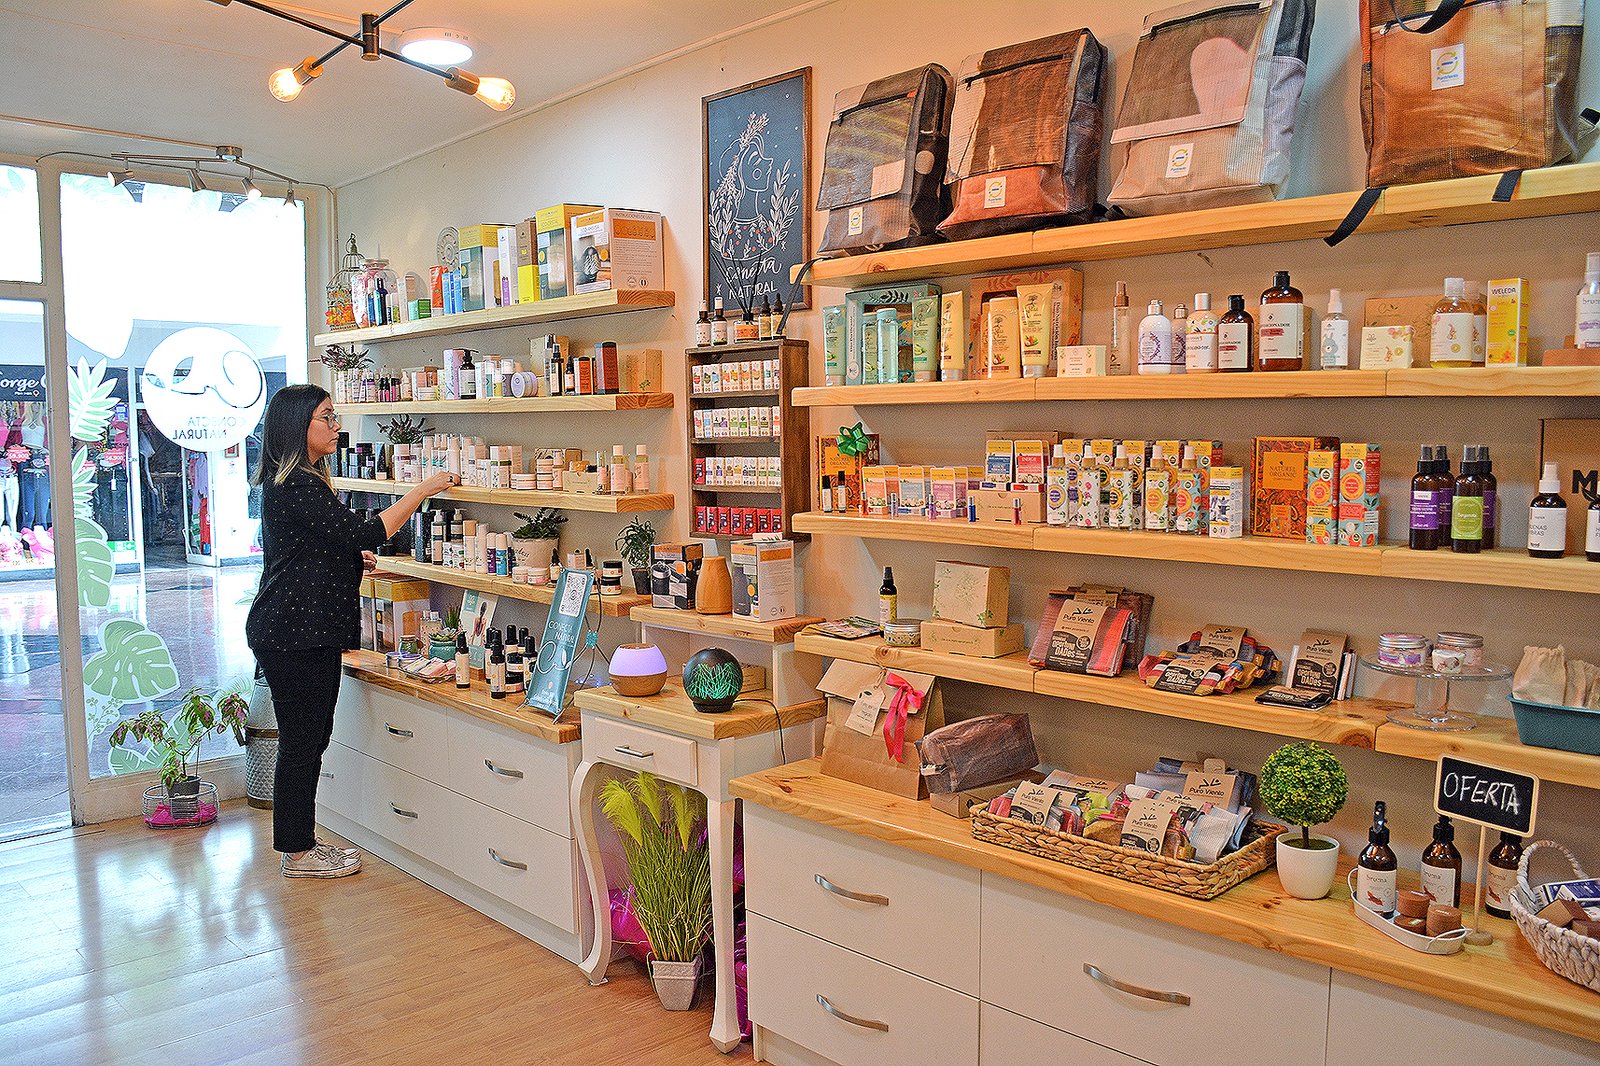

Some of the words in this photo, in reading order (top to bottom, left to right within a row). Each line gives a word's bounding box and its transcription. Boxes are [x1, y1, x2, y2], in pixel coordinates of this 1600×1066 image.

[1491, 287, 1517, 295] WELEDA
[1063, 613, 1076, 622] Puro
[1077, 615, 1095, 624] Viento
[1189, 787, 1204, 795] Puro
[1205, 788, 1226, 796] Viento
[1443, 772, 1519, 815] OFERTA
[1132, 819, 1142, 827] Puro
[1142, 820, 1159, 830] Viento
